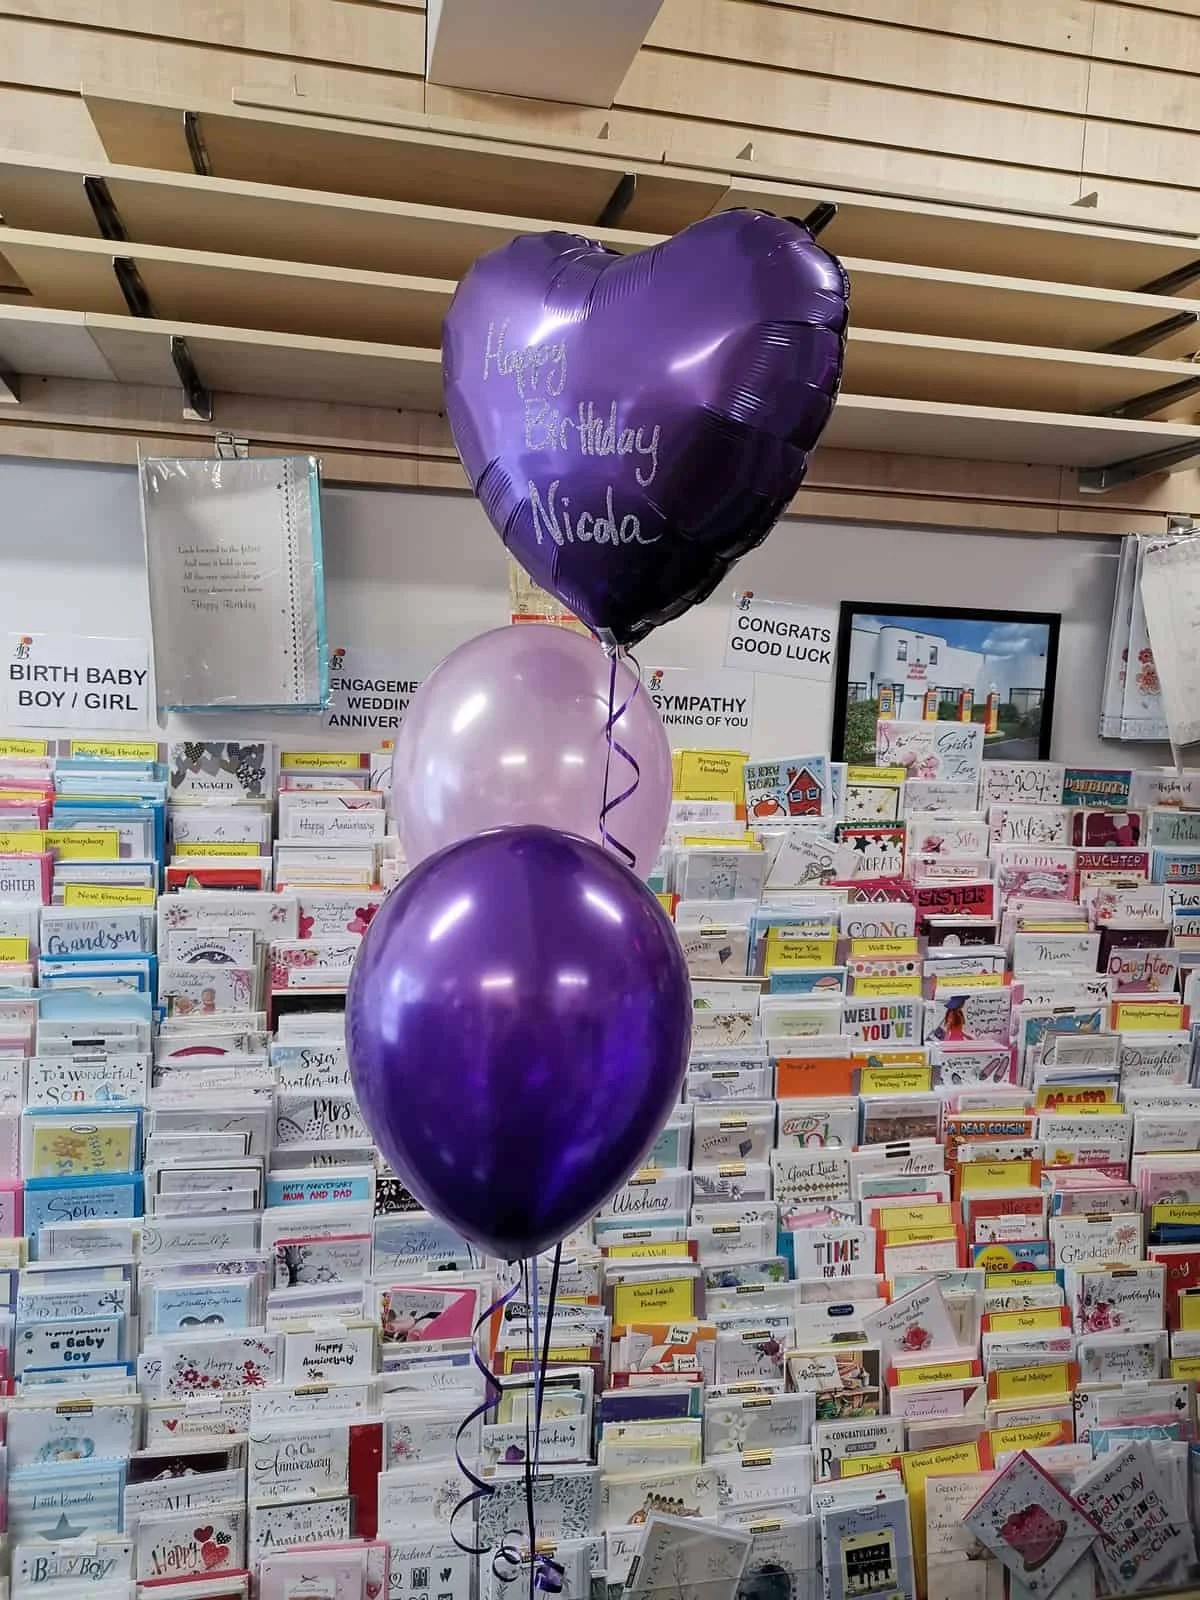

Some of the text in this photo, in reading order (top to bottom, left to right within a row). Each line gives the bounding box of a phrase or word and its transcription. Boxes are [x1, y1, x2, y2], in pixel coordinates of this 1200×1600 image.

[483, 318, 567, 398] Happy
[525, 399, 661, 487] Birthday
[528, 480, 663, 546] Nicola
[738, 616, 831, 643] CONGRATS
[731, 637, 832, 664] GOOD LUCK
[10, 664, 148, 686] BIRTH BABY
[331, 678, 420, 694] ENGAGEME
[18, 690, 66, 708] BOY
[84, 692, 139, 711] GIRL
[347, 697, 410, 711] WEDDIN
[652, 695, 747, 713] SYMPATHY
[328, 714, 402, 729] ANNIVER
[662, 714, 748, 727] INKING OF YOU
[191, 782, 233, 790] ENGAGED
[299, 818, 325, 836] Happy
[858, 855, 901, 872] NGRATS
[1078, 854, 1143, 867] DAUGHTER
[0, 879, 36, 892] GHTER
[48, 929, 139, 954] Grandson
[1107, 953, 1175, 982] Daughter
[843, 1004, 914, 1024] WELL DONE
[862, 1021, 913, 1042] YOU'VE
[301, 1049, 338, 1069] Sister
[40, 1069, 56, 1082] To
[960, 1123, 986, 1135] DEAR
[987, 1122, 1025, 1136] COUSIN
[788, 1159, 839, 1181] Good Luck
[282, 1180, 353, 1192] HAPPY ANNIVERSARY
[283, 1190, 353, 1200] MUM AND DAD
[613, 1189, 672, 1213] Wishing
[813, 1238, 860, 1265] TIME
[823, 1263, 851, 1278] FOR AN
[53, 1329, 74, 1337] proud
[76, 1327, 102, 1336] parents
[51, 1336, 105, 1350] a Baby
[315, 1342, 343, 1353] Happy
[63, 1350, 92, 1363] Boy
[303, 1353, 354, 1368] Anniversary
[832, 1427, 888, 1441] CONGRATULATIONS
[255, 1450, 332, 1476] Anniversary
[820, 1447, 833, 1477] R
[263, 1526, 345, 1547] Anniversary
[151, 1541, 199, 1575] Happy
[391, 1544, 434, 1562] Husband
[80, 1556, 118, 1580] Boy
